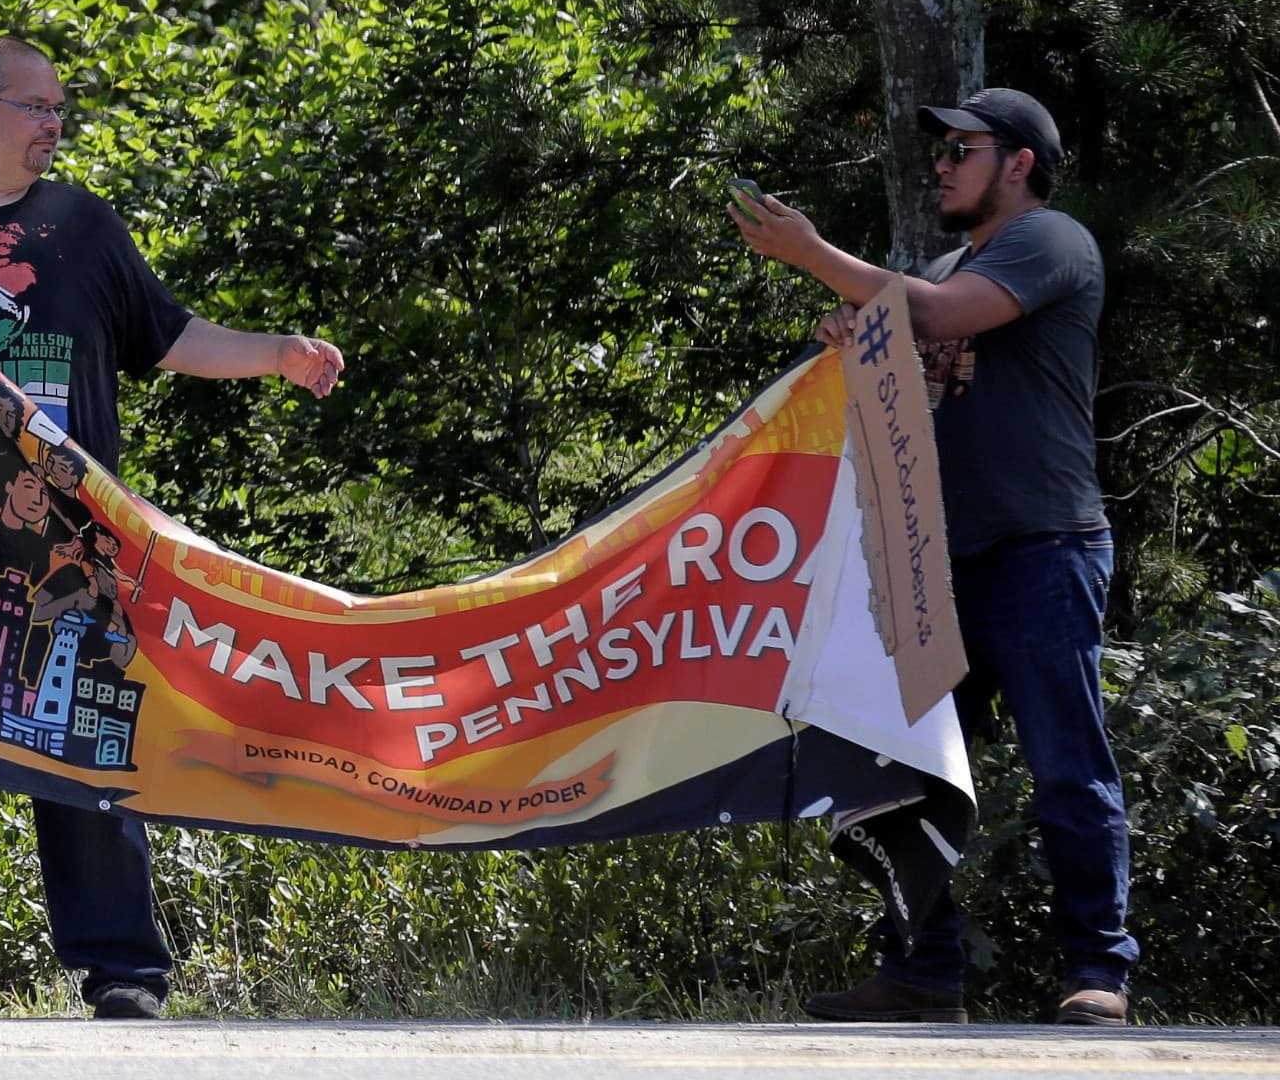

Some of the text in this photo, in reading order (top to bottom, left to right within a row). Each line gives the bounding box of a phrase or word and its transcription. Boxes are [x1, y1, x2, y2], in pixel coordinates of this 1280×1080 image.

[9, 345, 72, 361] MANDELA
[23, 332, 73, 349] NELSON
[163, 595, 445, 713] MAKE
[460, 563, 648, 688] THE
[415, 605, 797, 763] PENNSYLVA
[244, 744, 587, 814] DIGNIDAD, COMUNIDAD Y PODER
